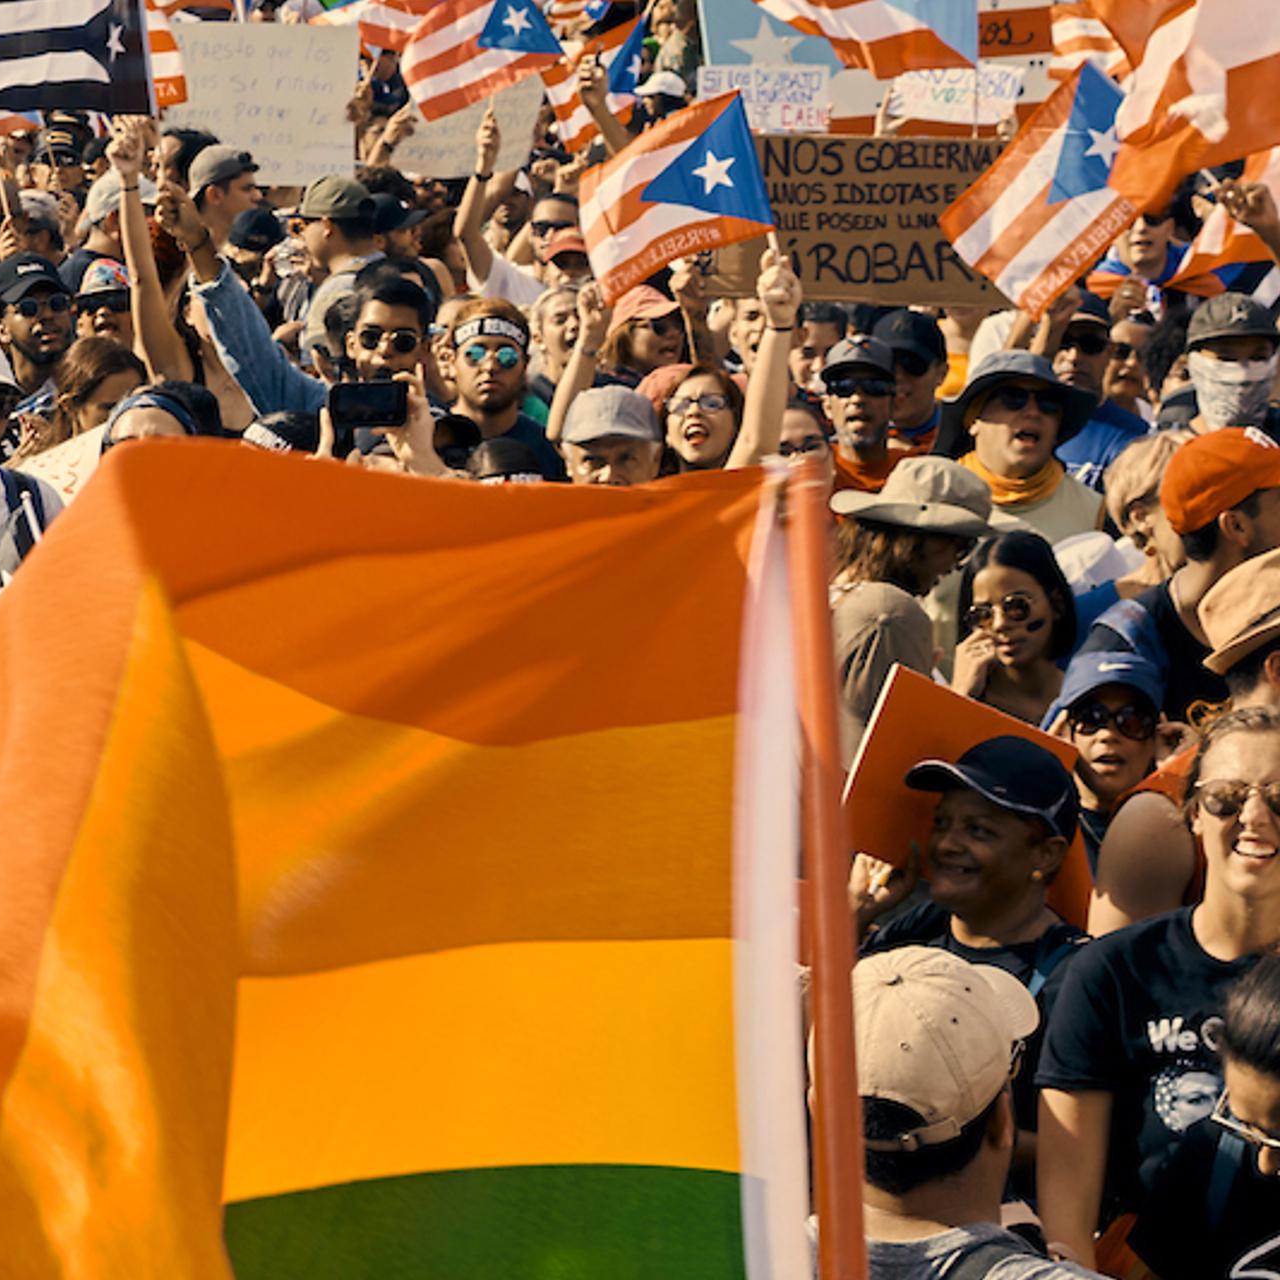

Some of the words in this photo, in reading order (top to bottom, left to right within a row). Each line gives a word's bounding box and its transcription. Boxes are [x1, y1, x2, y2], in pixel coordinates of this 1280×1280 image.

[763, 137, 848, 178] NOS
[832, 181, 942, 206] IDIOTAS
[816, 211, 888, 231] POSEEN
[897, 210, 941, 232] UNA
[1146, 1016, 1199, 1054] We
